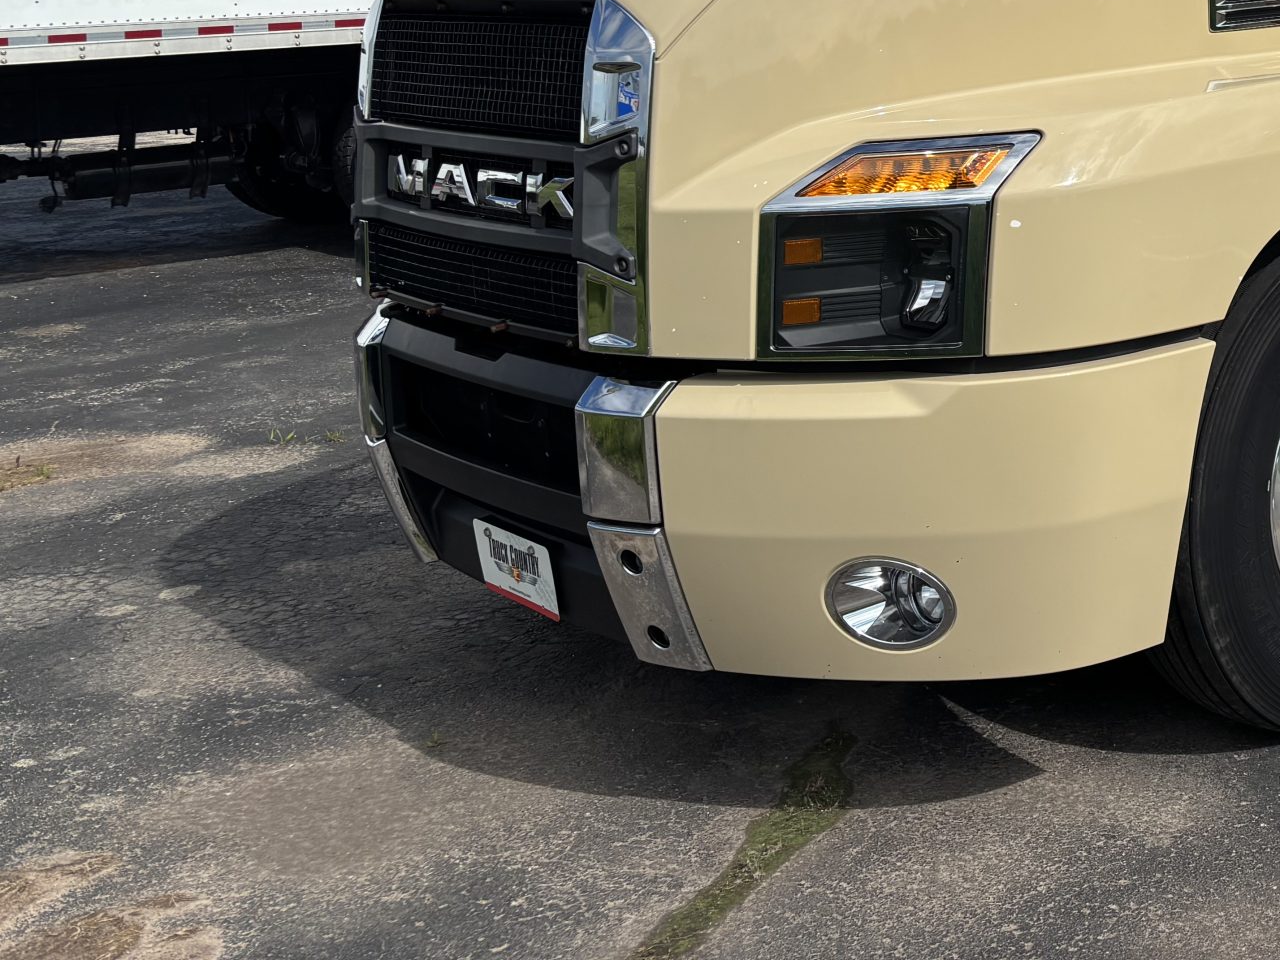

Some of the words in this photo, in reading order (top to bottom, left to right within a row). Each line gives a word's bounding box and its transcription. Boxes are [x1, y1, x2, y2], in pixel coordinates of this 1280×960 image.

[388, 154, 575, 218] MACK
[488, 536, 509, 566] TRUCK
[510, 543, 541, 579] COUNTRY
